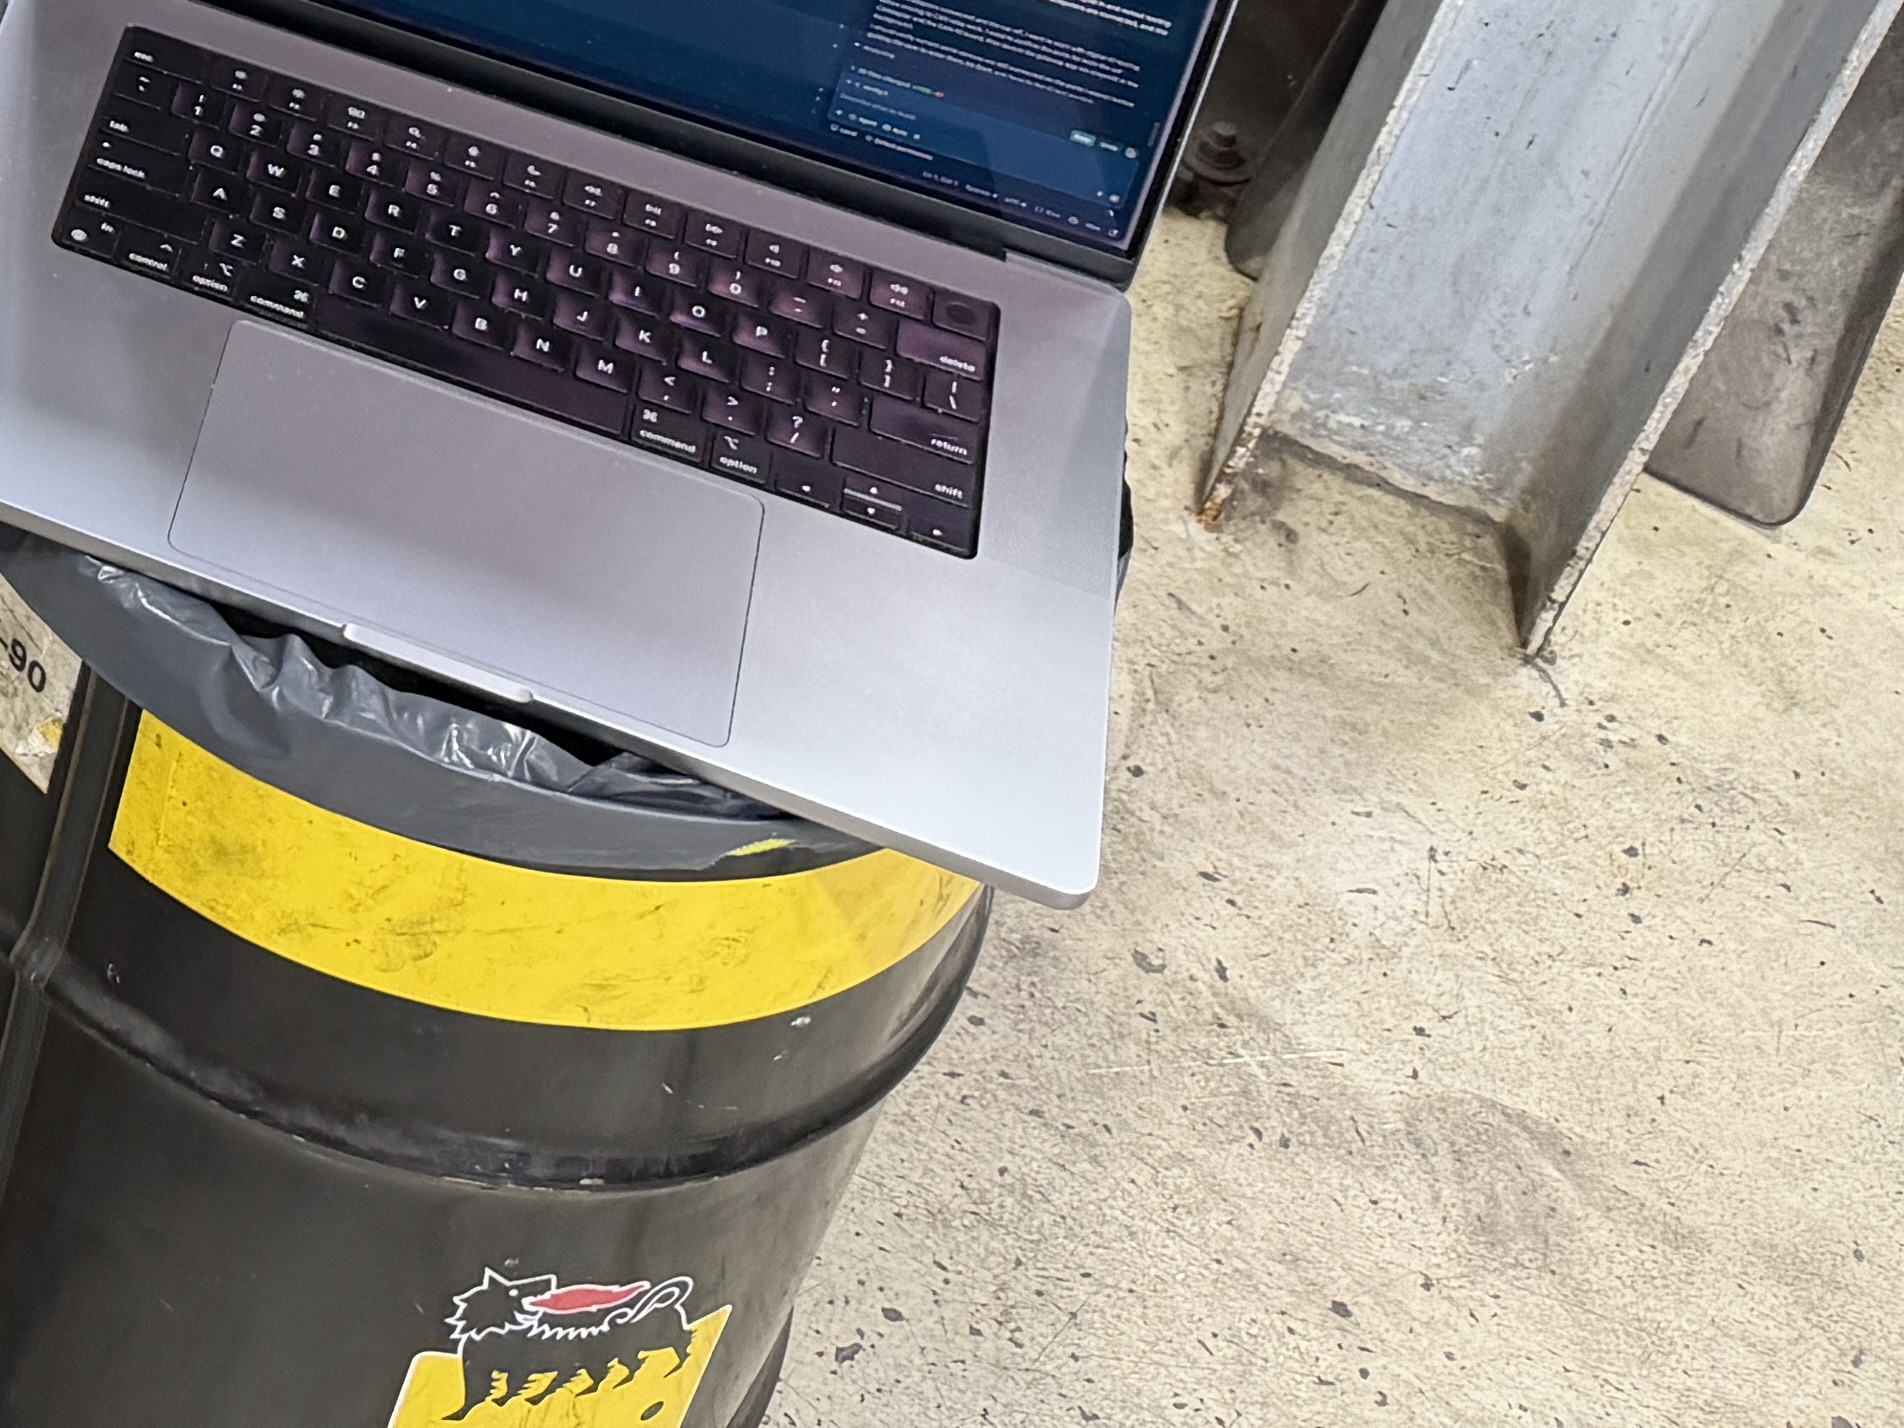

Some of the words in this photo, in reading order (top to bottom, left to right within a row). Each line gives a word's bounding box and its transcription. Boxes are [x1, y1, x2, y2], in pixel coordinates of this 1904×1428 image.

[211, 146, 223, 157] Q
[268, 164, 284, 176] W
[213, 188, 225, 199] A
[388, 205, 399, 216] R
[450, 225, 460, 236] T
[231, 234, 243, 246] Z
[394, 248, 404, 257] F
[510, 245, 520, 255] Y
[292, 255, 304, 267] X
[570, 265, 582, 277] U
[353, 277, 365, 288] C
[514, 289, 527, 301] H
[414, 297, 426, 308] V
[577, 312, 587, 321] J
[692, 306, 705, 317] O
[639, 330, 650, 342] K
[537, 339, 549, 351] N
[702, 351, 712, 363] L
[598, 360, 613, 373] M
[720, 457, 757, 473] option
